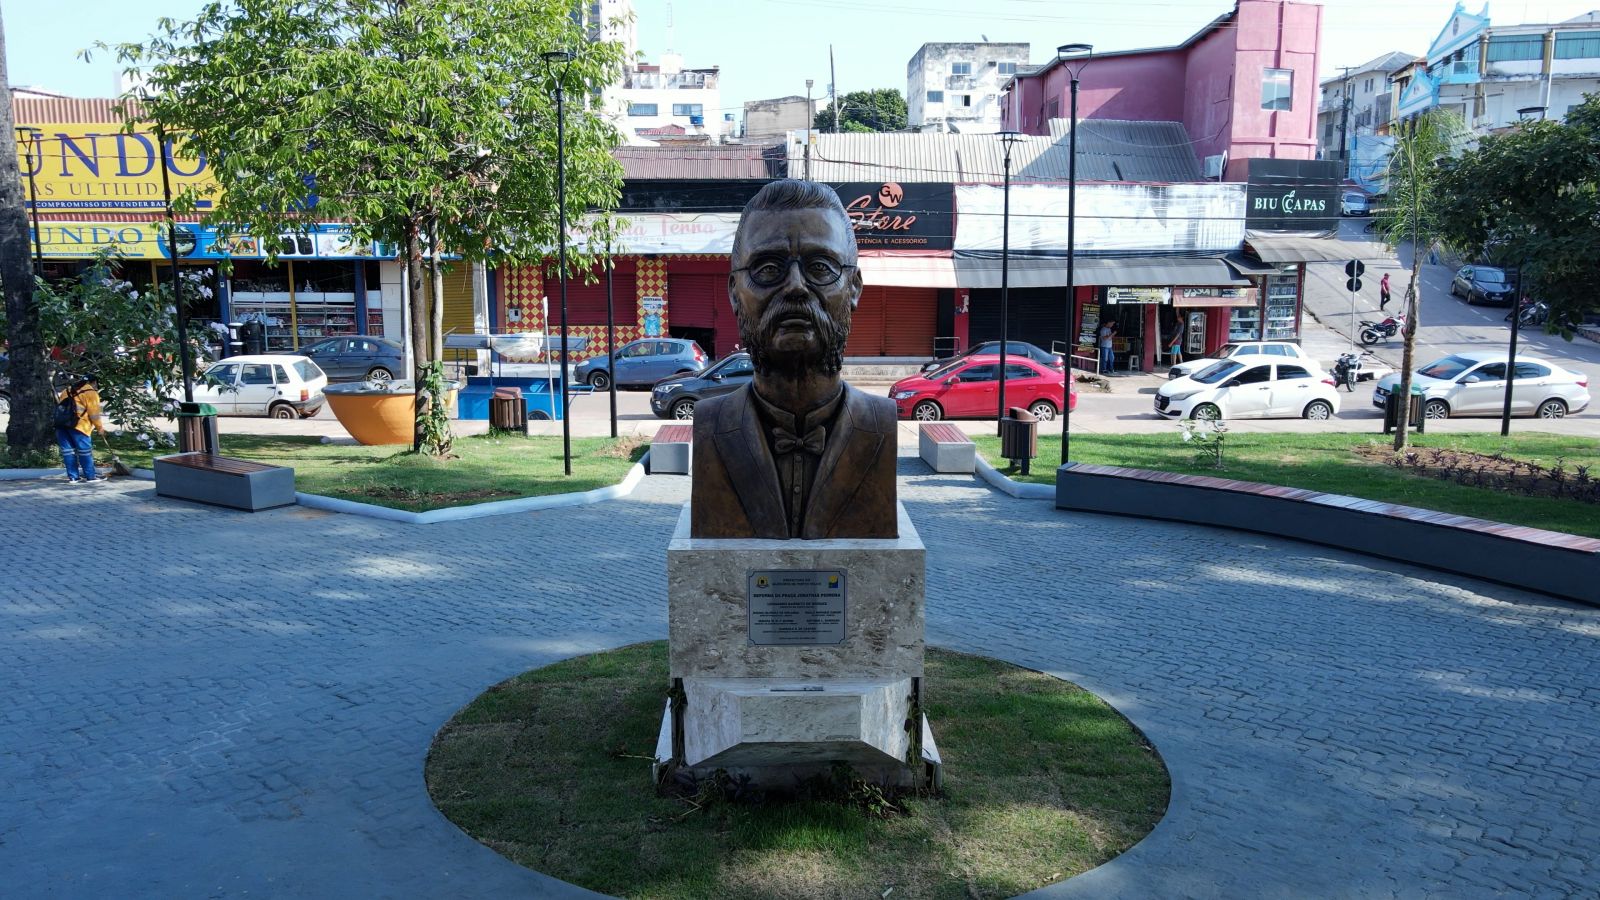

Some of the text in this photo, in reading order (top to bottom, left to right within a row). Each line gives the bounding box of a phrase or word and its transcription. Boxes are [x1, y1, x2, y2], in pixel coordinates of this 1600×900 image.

[1255, 197, 1326, 211] BIU CAPAS
[846, 194, 917, 230] Store
[856, 236, 882, 244] STÊNCIA
